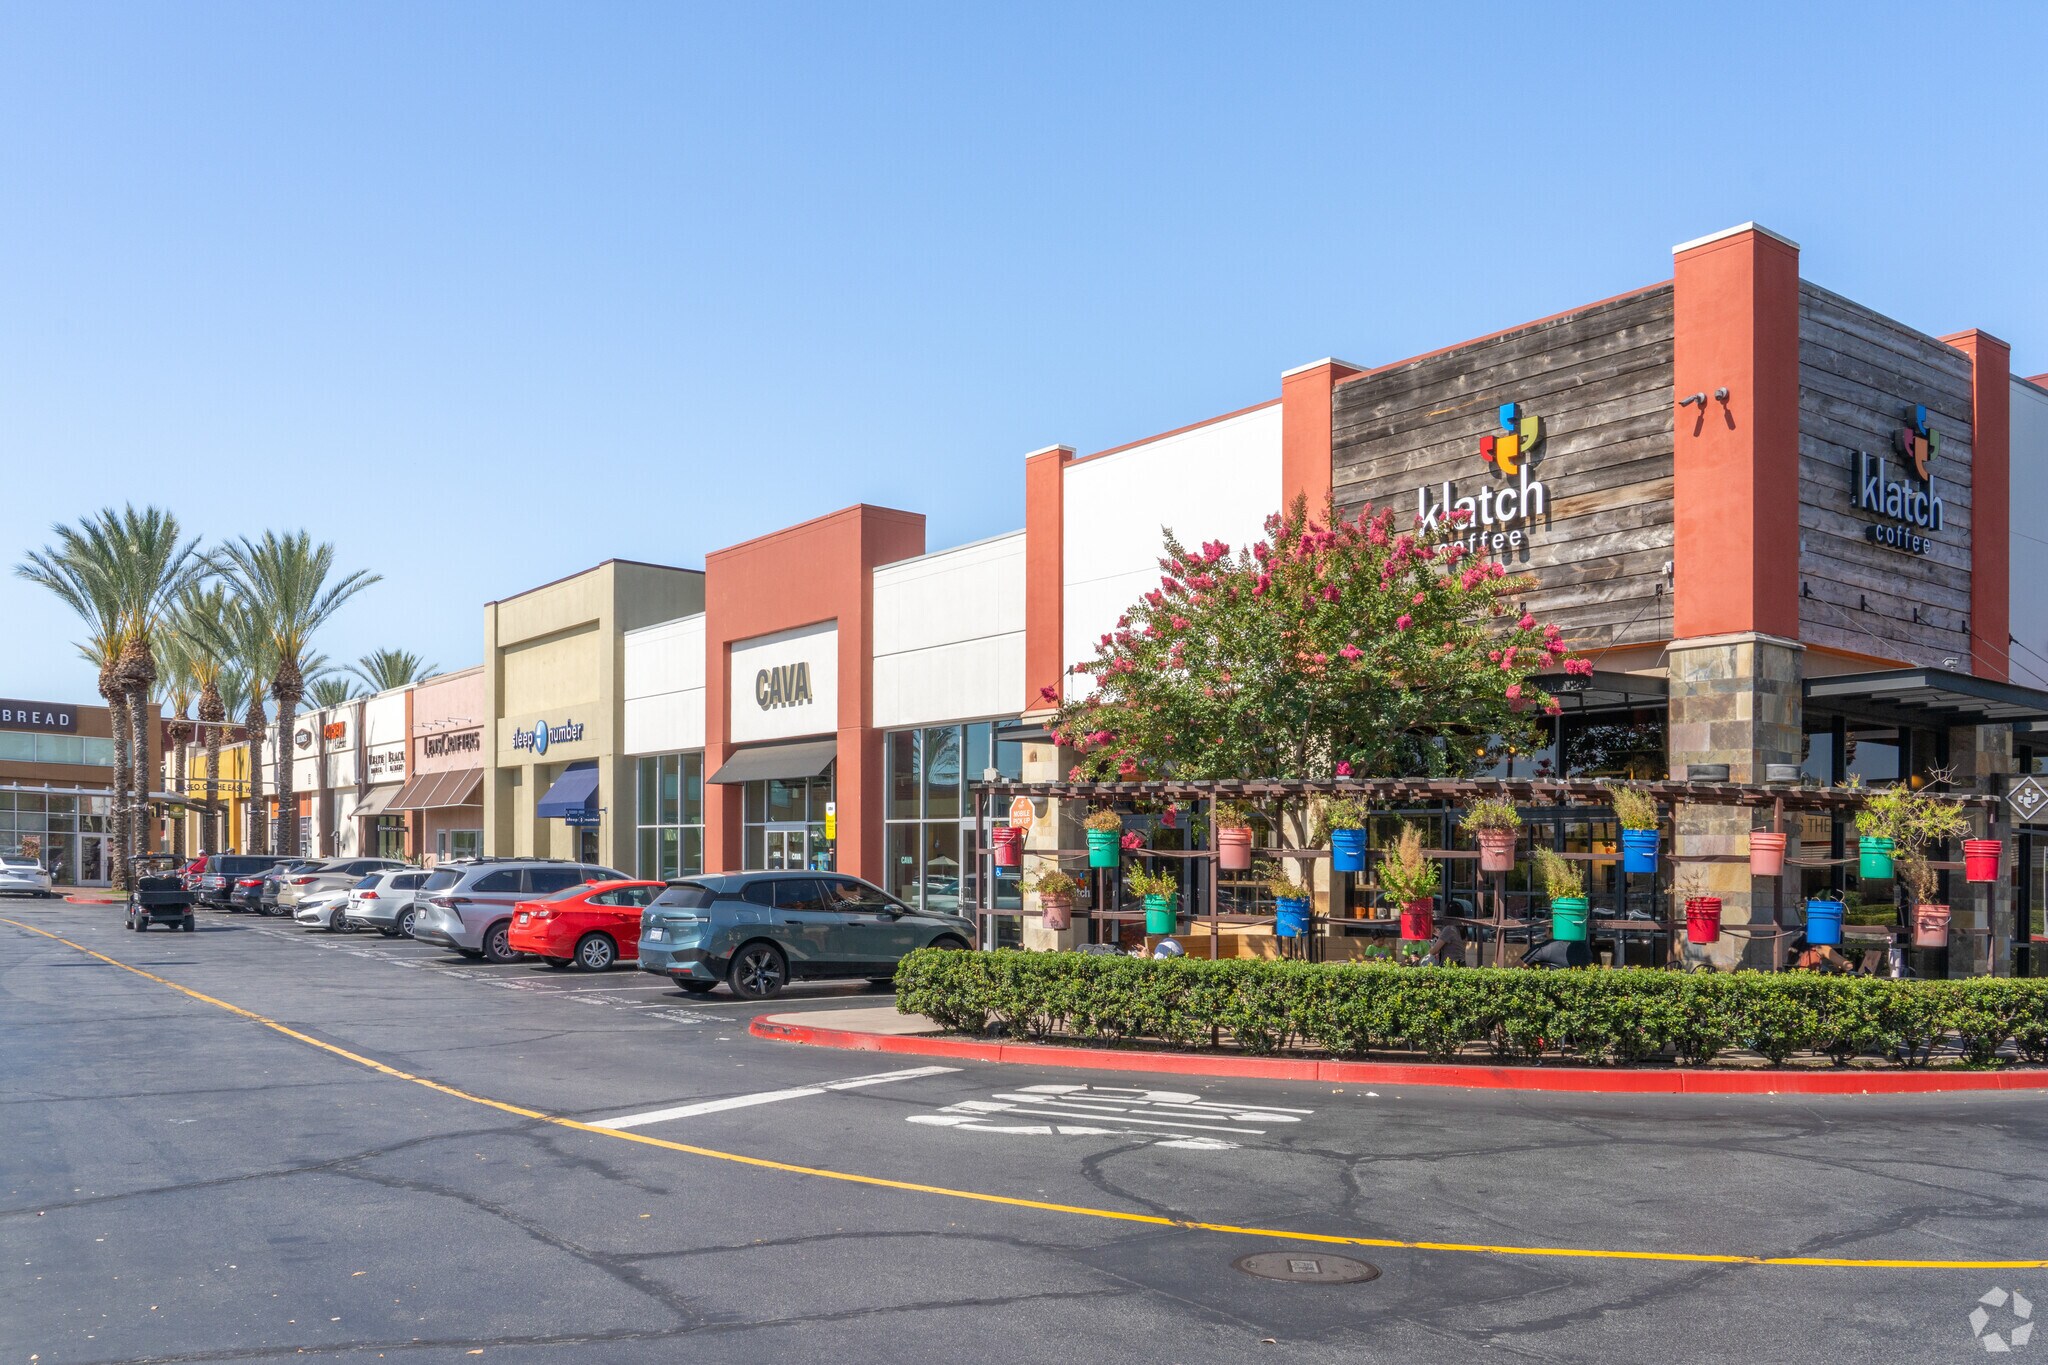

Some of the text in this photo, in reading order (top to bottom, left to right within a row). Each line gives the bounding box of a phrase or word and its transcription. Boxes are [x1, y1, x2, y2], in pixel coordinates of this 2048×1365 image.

[1418, 463, 1544, 538] klatch
[1862, 450, 1944, 531] klatch
[1876, 524, 1931, 554] coffee
[755, 661, 811, 708] CAVA
[2, 709, 69, 726] BREAD
[511, 719, 583, 752] sleep number
[901, 856, 913, 864] CAVA
